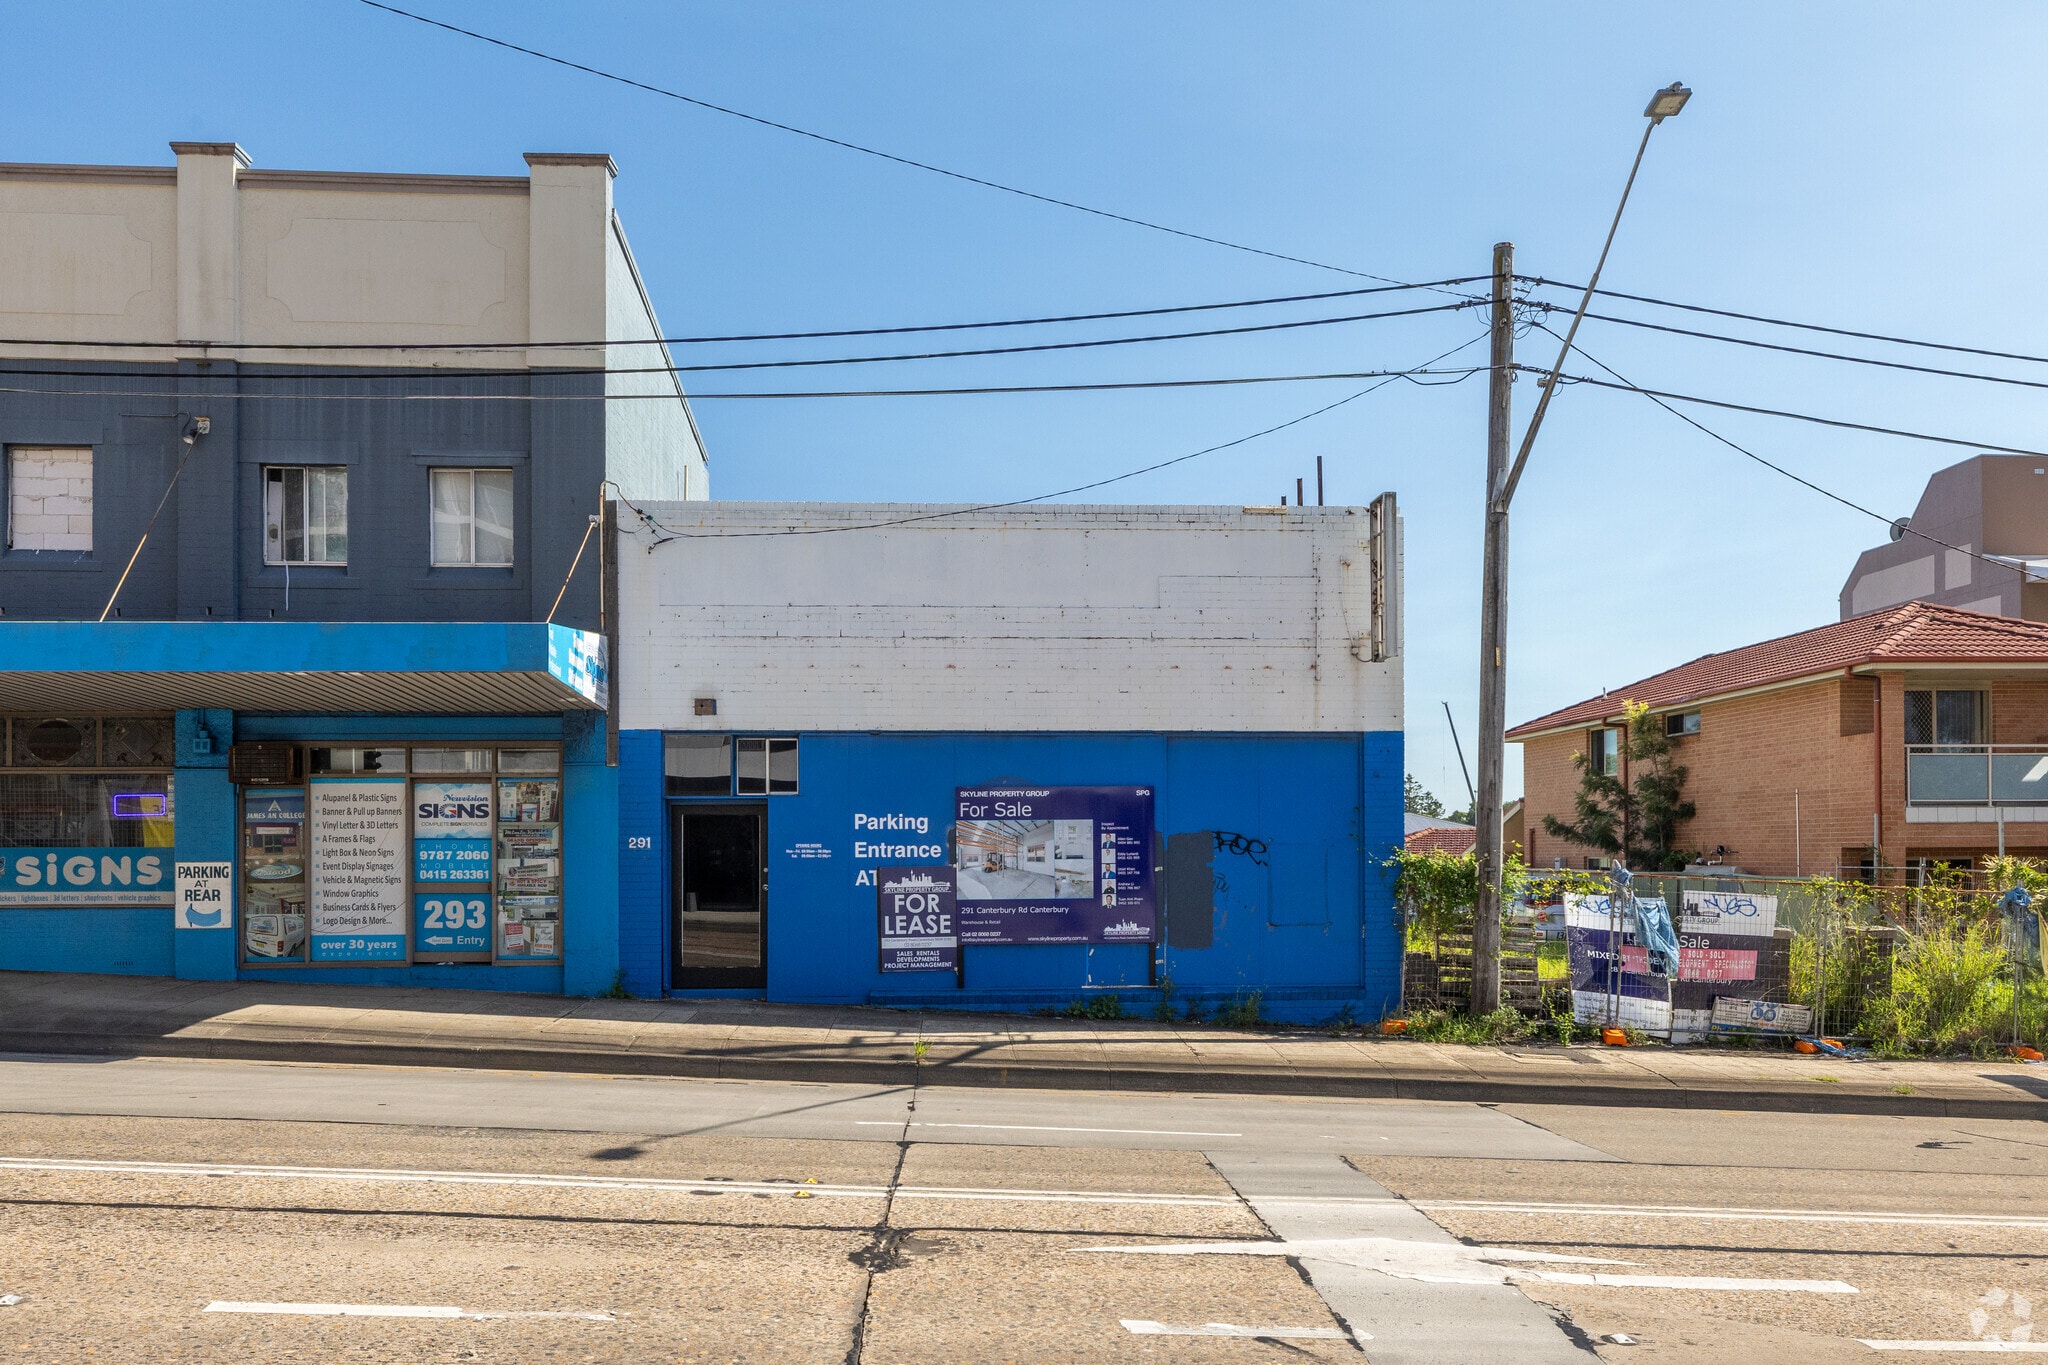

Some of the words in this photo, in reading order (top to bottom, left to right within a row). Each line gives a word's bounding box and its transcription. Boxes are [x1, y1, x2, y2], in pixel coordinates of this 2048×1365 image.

[322, 794, 350, 803] Alupanel
[381, 794, 397, 803] Signs
[419, 804, 489, 818] SIGNS
[960, 803, 988, 817] For
[995, 802, 1032, 817] Sale
[322, 821, 338, 831] Vinyl
[377, 822, 398, 830] Letters
[854, 814, 928, 834] Parking
[360, 835, 376, 844] Flags
[628, 837, 651, 848] 291
[322, 849, 338, 858] Light
[378, 848, 394, 858] Signs
[854, 842, 942, 858] Entrance
[420, 851, 452, 860] 9787
[456, 851, 489, 860] 2060
[342, 862, 365, 871] Display
[366, 863, 394, 872] Signages
[178, 866, 229, 879] PARKING
[420, 870, 447, 879] 0415
[450, 870, 489, 879] 263361
[354, 876, 384, 885] Magnetic
[385, 876, 401, 885] Signs
[21, 894, 49, 902] lightboxes
[84, 894, 113, 902] shopfronts
[138, 894, 161, 902] graphics
[185, 889, 221, 901] REAR
[351, 890, 379, 899] Graphics
[378, 903, 396, 912] Flyers
[895, 894, 940, 913] FOR
[424, 901, 486, 929] 293
[323, 917, 338, 926] Logo
[340, 917, 360, 926] Design
[884, 915, 951, 935] LEASE
[349, 940, 365, 949] 30
[367, 942, 397, 951] years
[457, 936, 485, 947] Entry
[1680, 936, 1709, 948] Sale
[1710, 951, 1725, 959] SOLD
[1679, 959, 1709, 968] ELOPMENT
